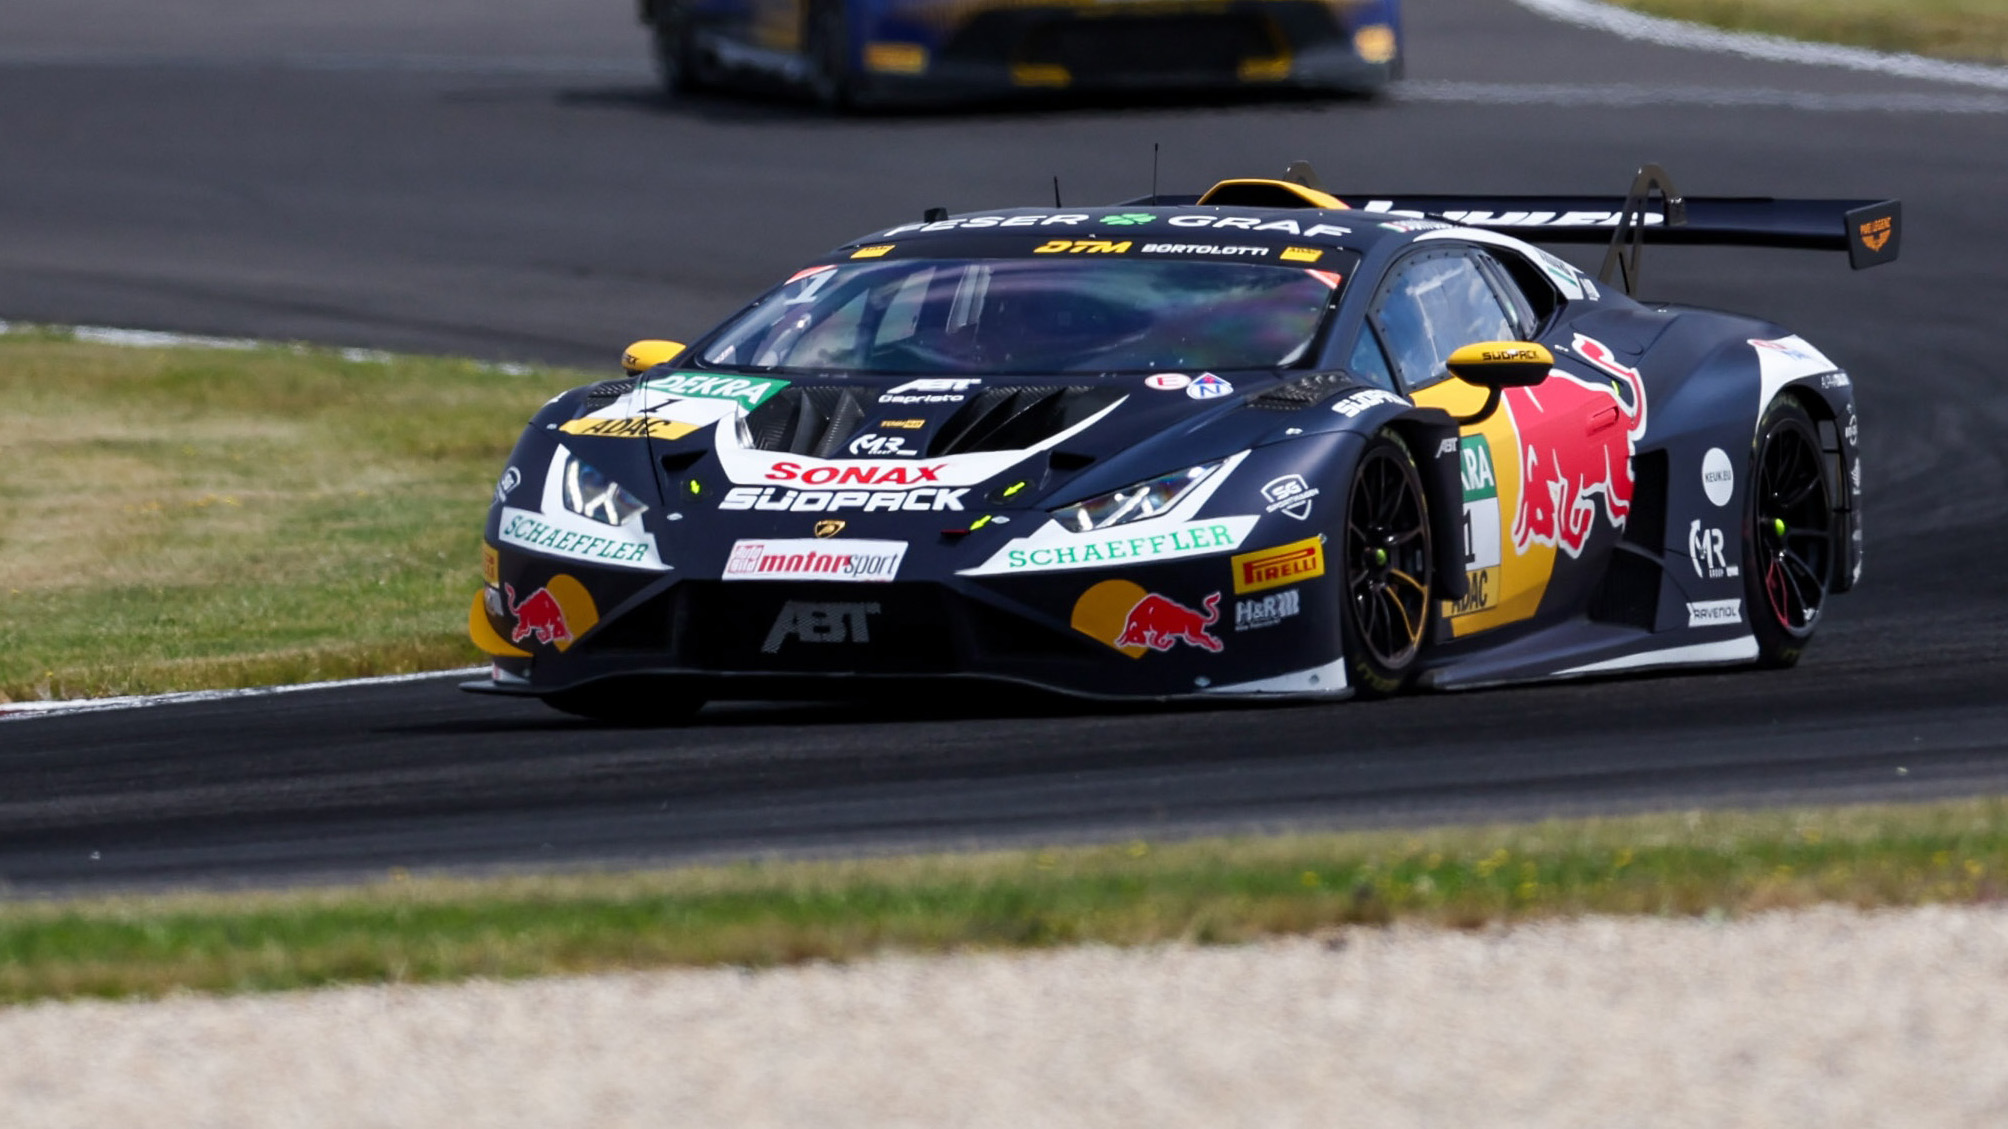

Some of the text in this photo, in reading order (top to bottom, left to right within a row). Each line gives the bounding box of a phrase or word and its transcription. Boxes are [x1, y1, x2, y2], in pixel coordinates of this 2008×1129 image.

[1168, 215, 1352, 237] GRAF
[1033, 240, 1133, 254] DTM
[1141, 243, 1270, 256] BORTOLOTTI
[646, 375, 772, 404] DEKRA
[886, 378, 982, 394] ABT
[581, 418, 671, 437] ADAC
[1435, 437, 1458, 459] ABT
[764, 462, 949, 485] SONAX
[504, 514, 650, 562] SCHAEFFLER
[1008, 525, 1235, 568] SCHAEFFLER
[1243, 547, 1317, 585] PIRELLI
[761, 600, 881, 653] ABT
